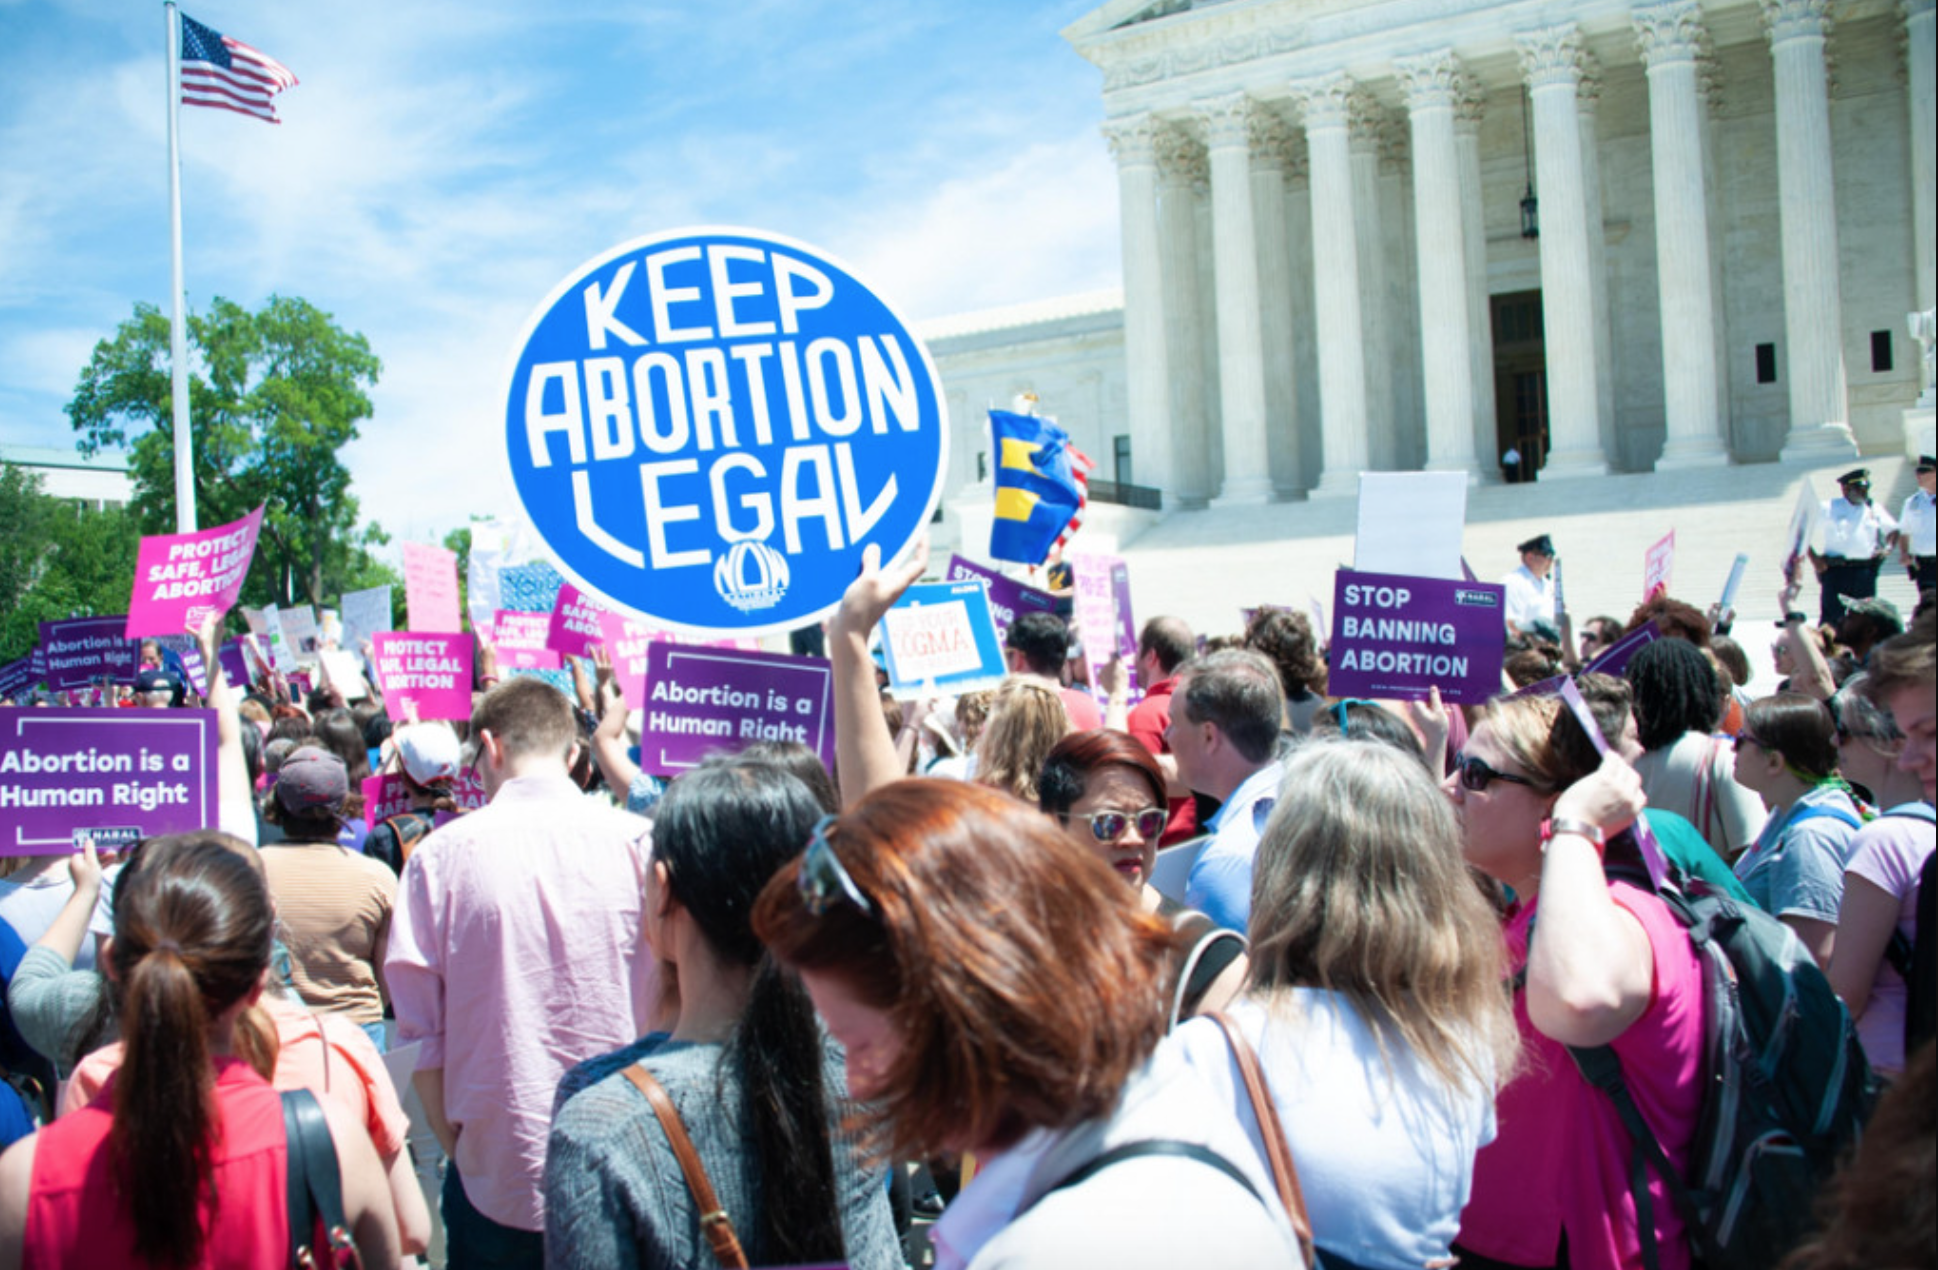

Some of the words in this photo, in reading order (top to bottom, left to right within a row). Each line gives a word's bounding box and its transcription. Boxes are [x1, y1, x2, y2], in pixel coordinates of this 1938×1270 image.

[583, 244, 835, 350] KEEP
[524, 334, 920, 468] ABORTION
[571, 441, 899, 570] LEGAL
[168, 525, 250, 561] PROTECT
[148, 560, 206, 582] SAFE,
[1344, 584, 1411, 609] STOP
[47, 635, 112, 655] Abortion
[1342, 616, 1456, 645] BANNING
[49, 651, 101, 670] Human
[406, 658, 463, 672] LEGAL
[1340, 648, 1468, 678] ABORTION
[651, 680, 760, 710] Abortion
[767, 688, 788, 712] is
[795, 697, 812, 714] a
[650, 711, 732, 736] Human
[739, 718, 808, 745] Right
[0, 748, 132, 772] Abortion
[140, 748, 164, 772] is
[172, 754, 190, 772] a
[0, 784, 104, 807] Human
[112, 781, 188, 811] Right
